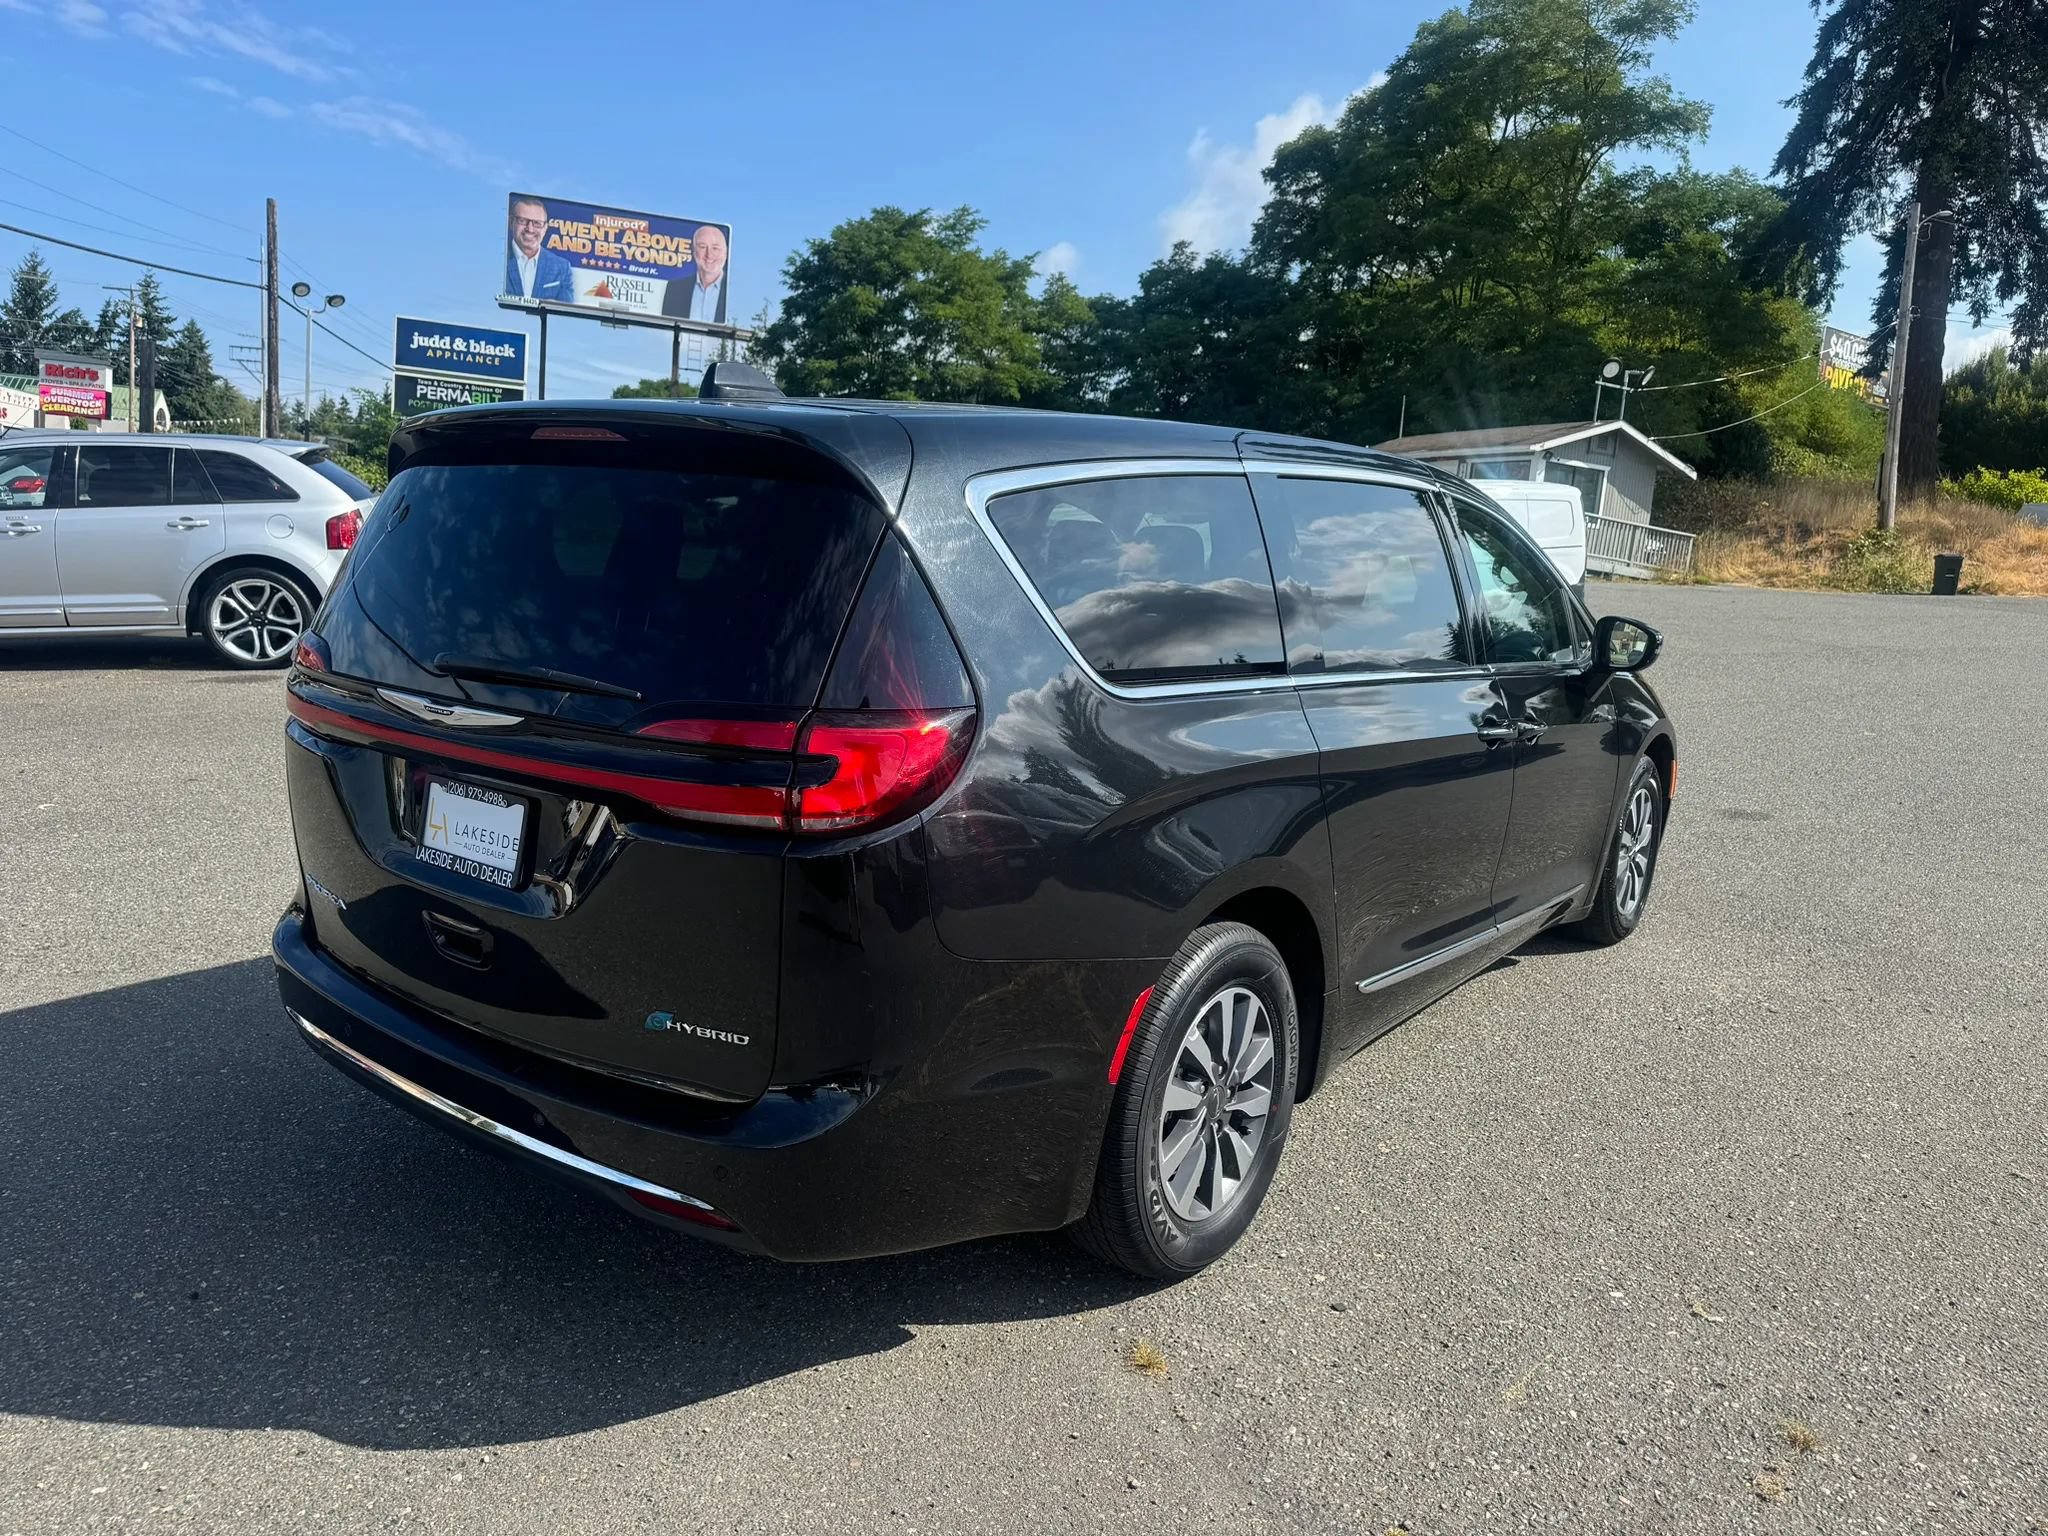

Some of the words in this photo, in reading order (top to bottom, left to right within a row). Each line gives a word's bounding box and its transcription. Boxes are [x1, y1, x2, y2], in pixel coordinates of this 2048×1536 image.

[595, 215, 646, 230] Injured?
[546, 234, 592, 254] AND
[621, 229, 692, 253] ABOVE
[628, 264, 649, 274] Brad
[649, 266, 659, 275] K.
[605, 274, 654, 293] RUSSELL
[410, 332, 451, 350] judd
[452, 337, 468, 352] &
[469, 339, 516, 358] black
[426, 349, 500, 366] APPLIANCE
[40, 377, 63, 385] STOVES
[44, 363, 99, 382] Rich's
[417, 378, 432, 386] Town
[44, 396, 102, 407] OVERSTOCK
[51, 388, 95, 400] SUMMER
[416, 385, 502, 405] PERMABILT
[447, 780, 466, 798] (206)
[467, 786, 503, 807] 979-4988
[454, 821, 519, 853] LAKESIDE
[463, 842, 480, 854] AUTO
[481, 846, 506, 861] DEALER
[415, 845, 452, 870] LAKESIDE
[454, 858, 479, 878] AUTO
[480, 865, 513, 889] DEALER
